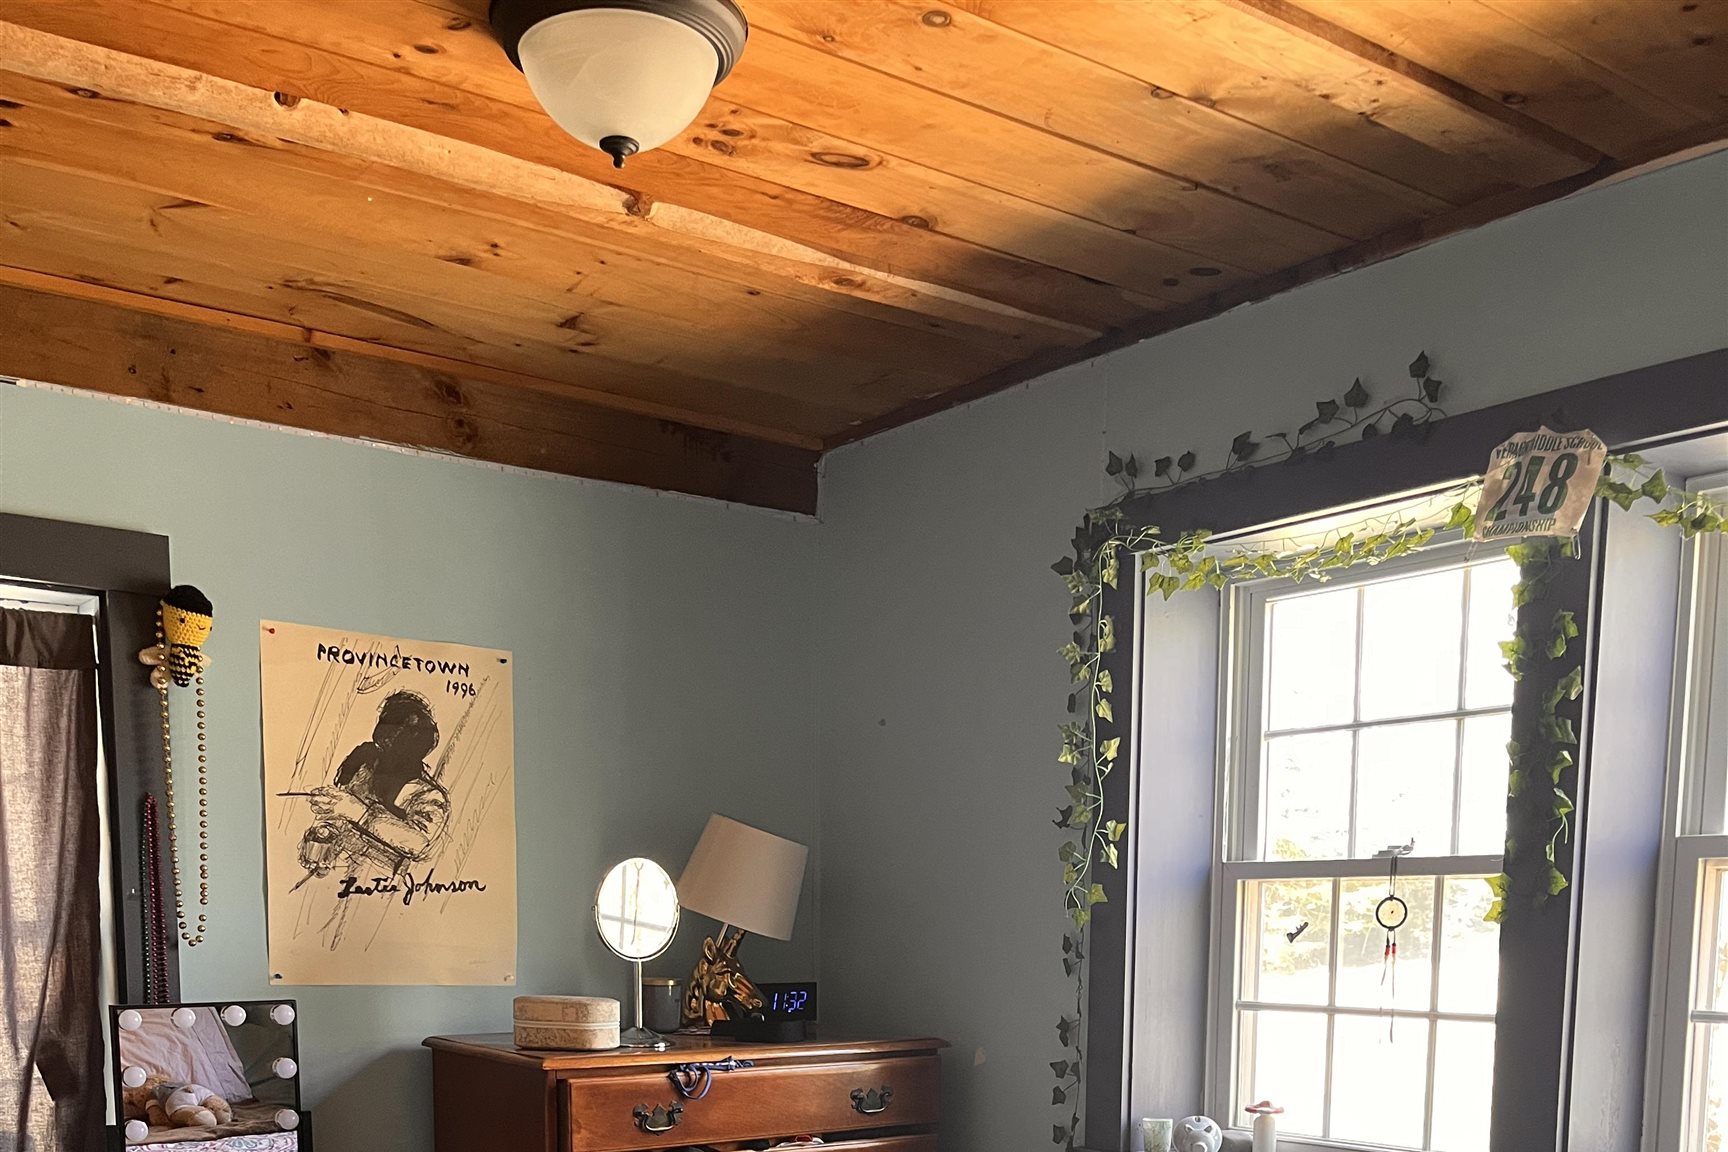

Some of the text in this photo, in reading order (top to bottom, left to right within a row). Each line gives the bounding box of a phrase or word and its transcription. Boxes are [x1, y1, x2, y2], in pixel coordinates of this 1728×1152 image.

[1564, 436, 1603, 451] SCHOOL
[1484, 452, 1579, 522] 248
[1482, 518, 1557, 539] CHAMPIONSHIP
[316, 642, 470, 678] PROVINCETOWN
[446, 680, 477, 699] 1996
[402, 868, 487, 905] Johnson
[772, 991, 807, 1013] 11:32
